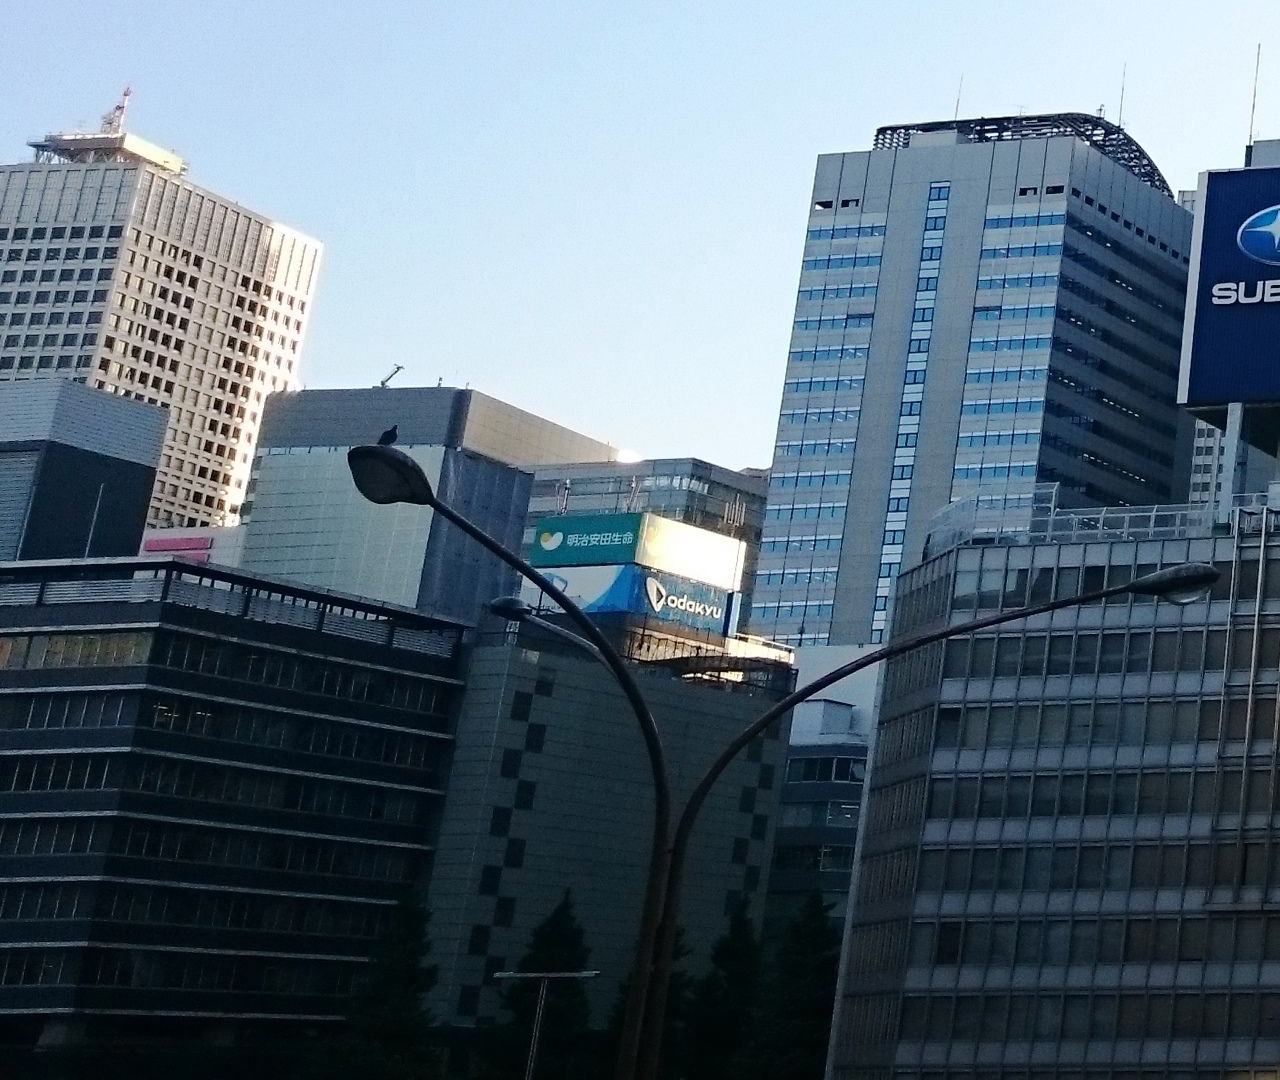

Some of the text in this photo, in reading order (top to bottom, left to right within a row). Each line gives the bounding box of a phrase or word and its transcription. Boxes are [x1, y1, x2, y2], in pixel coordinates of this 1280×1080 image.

[566, 531, 634, 548] 明治安田生命
